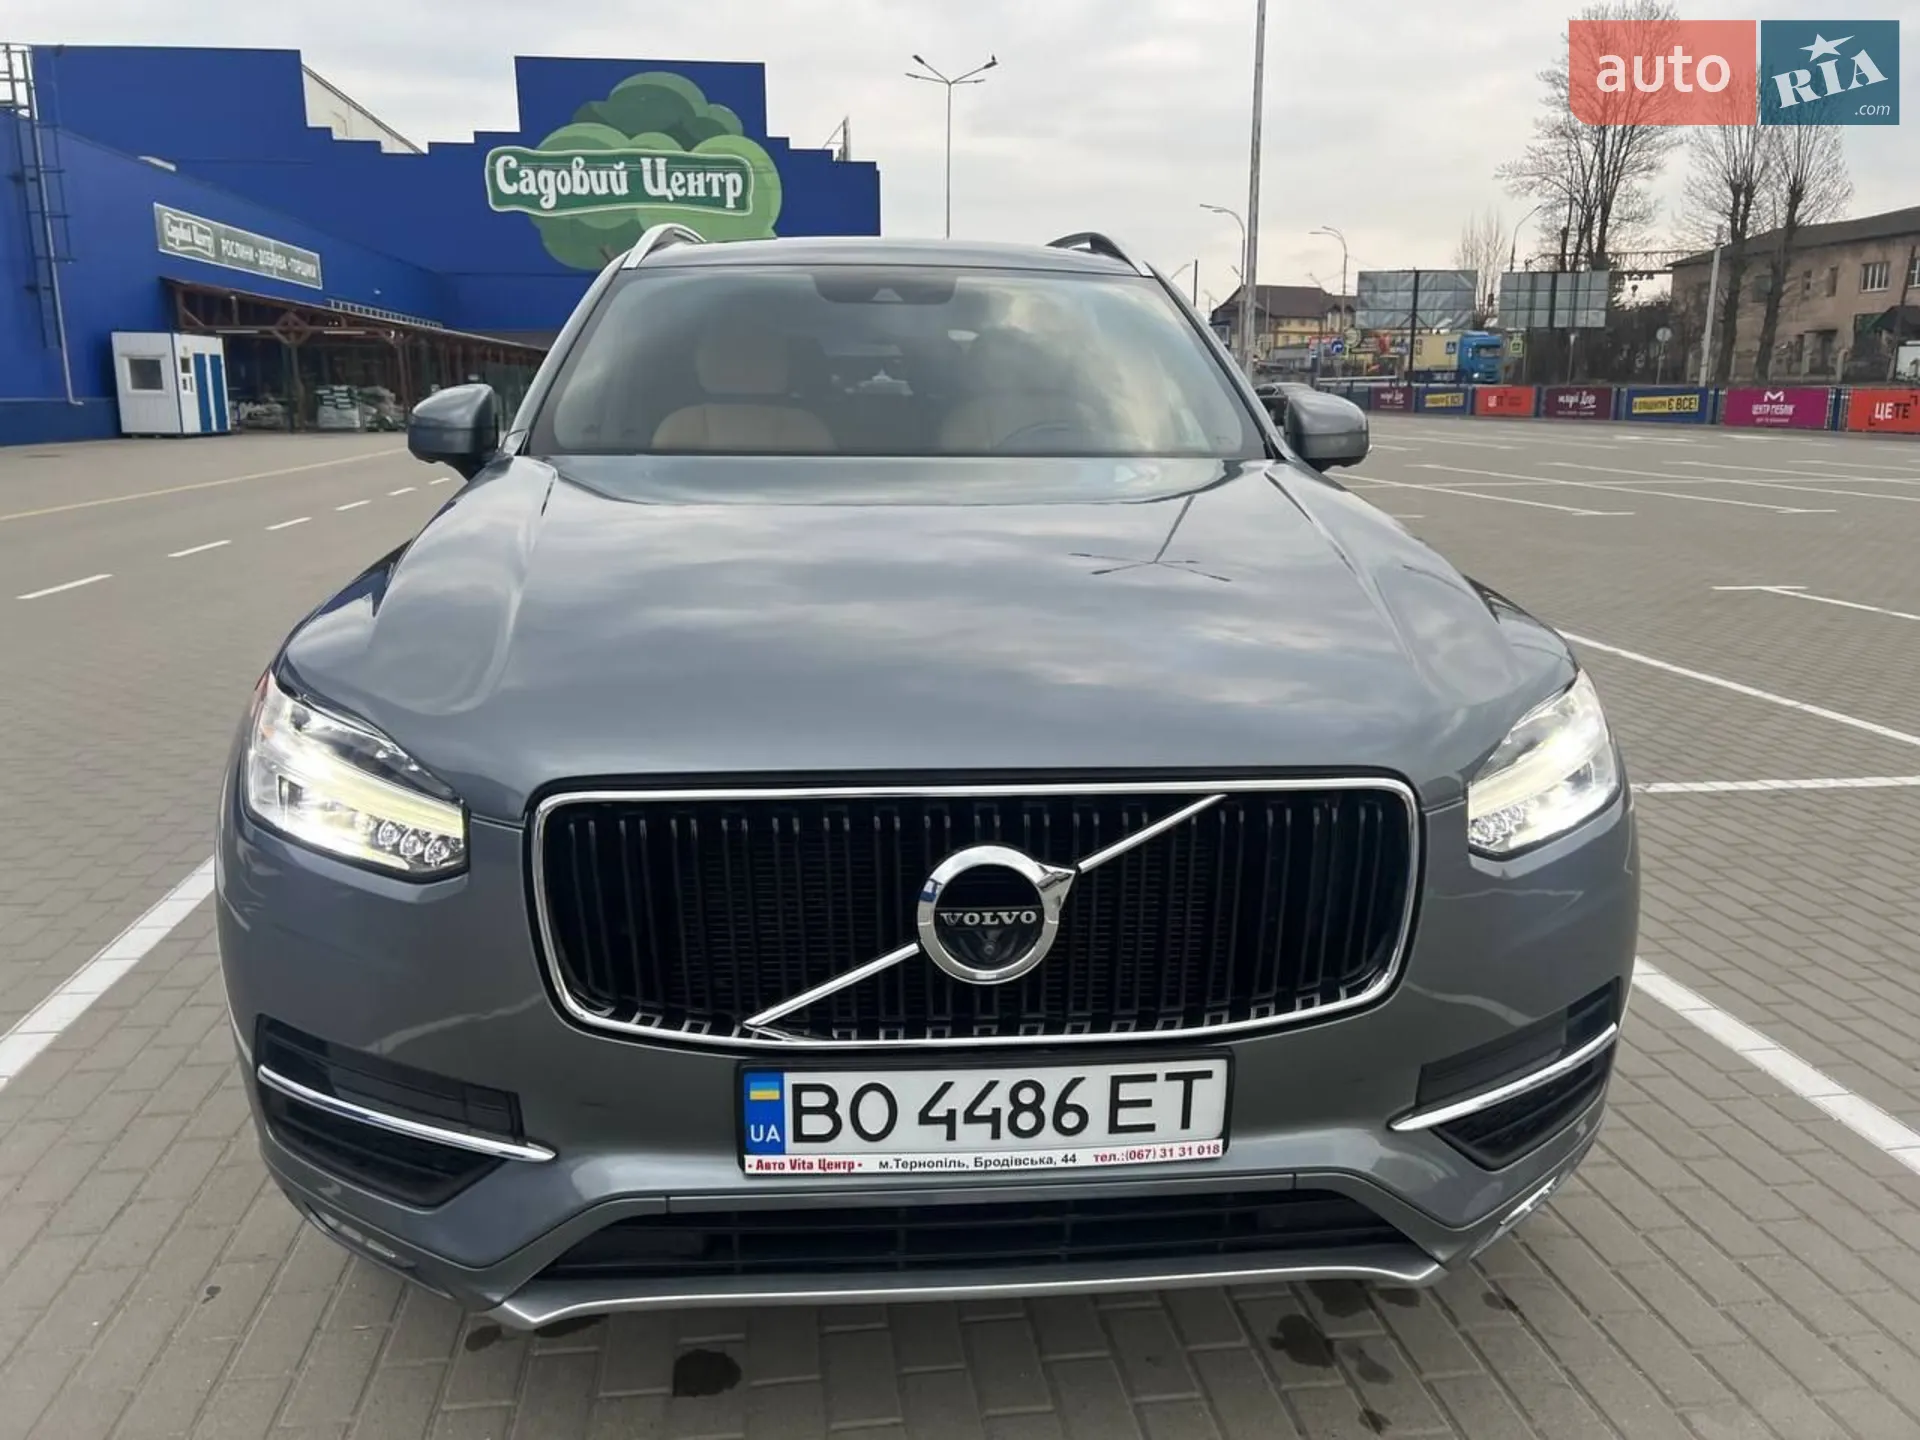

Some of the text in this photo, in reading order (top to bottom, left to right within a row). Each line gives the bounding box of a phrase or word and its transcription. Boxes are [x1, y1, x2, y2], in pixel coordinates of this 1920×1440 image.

[496, 155, 743, 209] Садовий Центр
[220, 238, 255, 263] РОСЛИНИ
[1874, 402, 1911, 421] ЦЕТЕ
[940, 911, 1037, 926] VOLVO
[791, 1069, 1213, 1143] BO 4486 ET
[750, 1124, 781, 1143] UA
[1160, 1146, 1175, 1158] 31
[1178, 1145, 1193, 1157] 31
[1197, 1143, 1221, 1156] 018
[755, 1157, 856, 1173] Авто Vita Центр
[973, 1154, 1057, 1169] Бродівська,
[1060, 1153, 1078, 1164] 44
